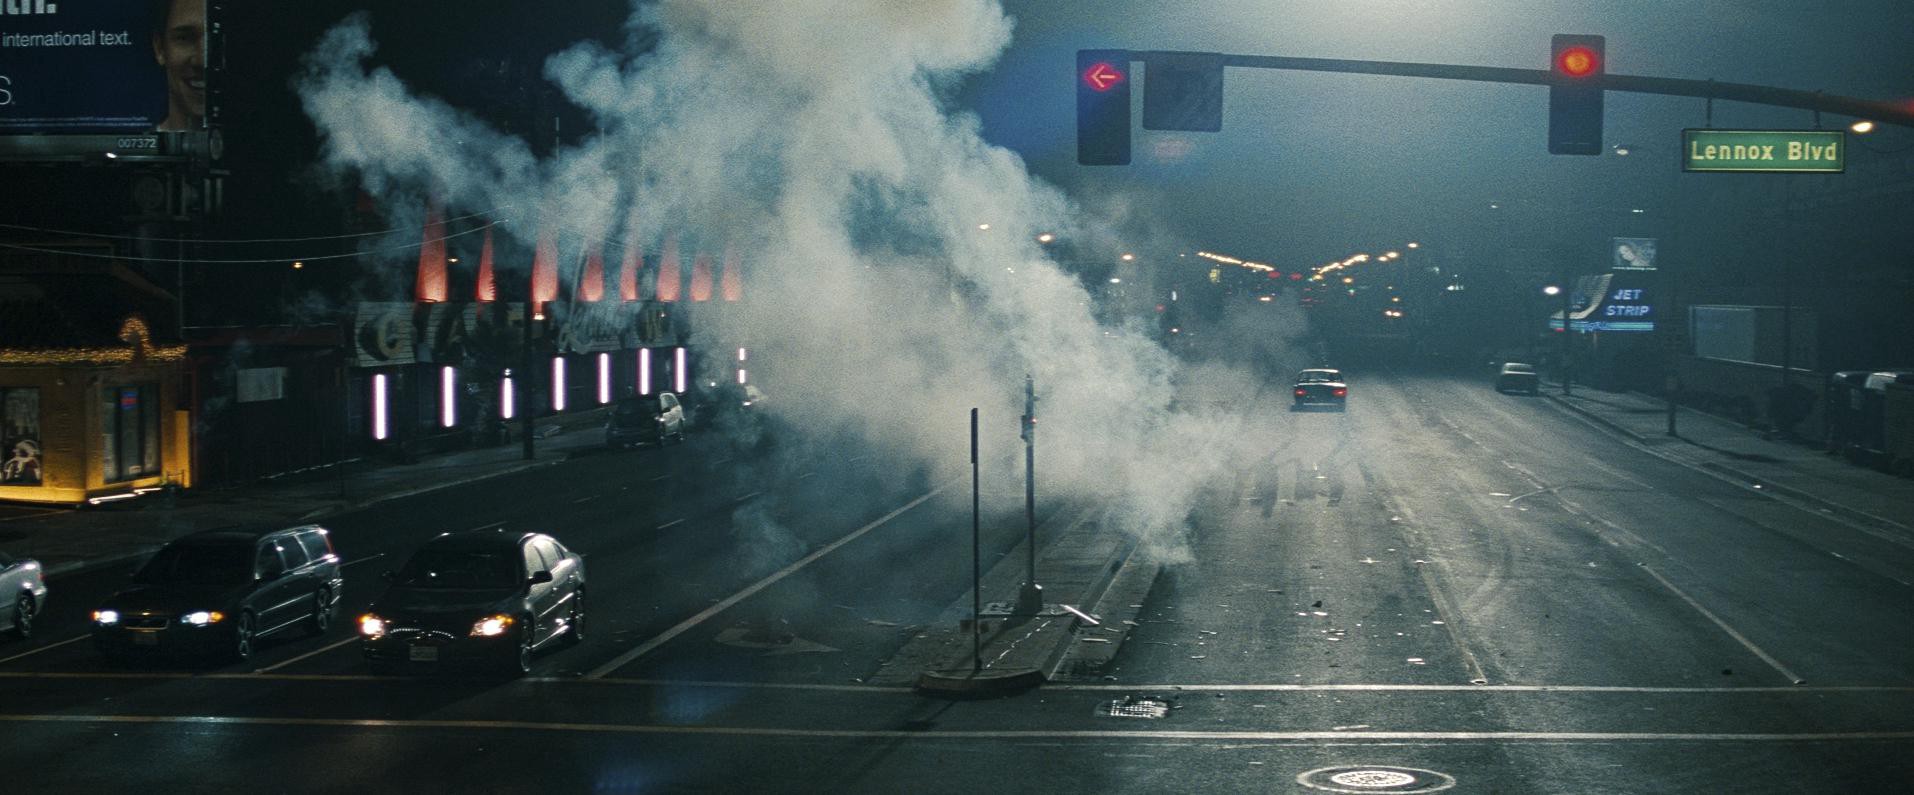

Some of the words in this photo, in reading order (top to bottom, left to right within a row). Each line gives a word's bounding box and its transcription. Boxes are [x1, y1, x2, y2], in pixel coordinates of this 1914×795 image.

[2, 30, 96, 47] international
[100, 30, 132, 46] text.
[118, 138, 157, 148] 007372
[1691, 141, 1775, 160] Lennox
[1787, 141, 1837, 161] Blvd
[1613, 289, 1642, 300] JET
[1606, 305, 1650, 316] STRIP
